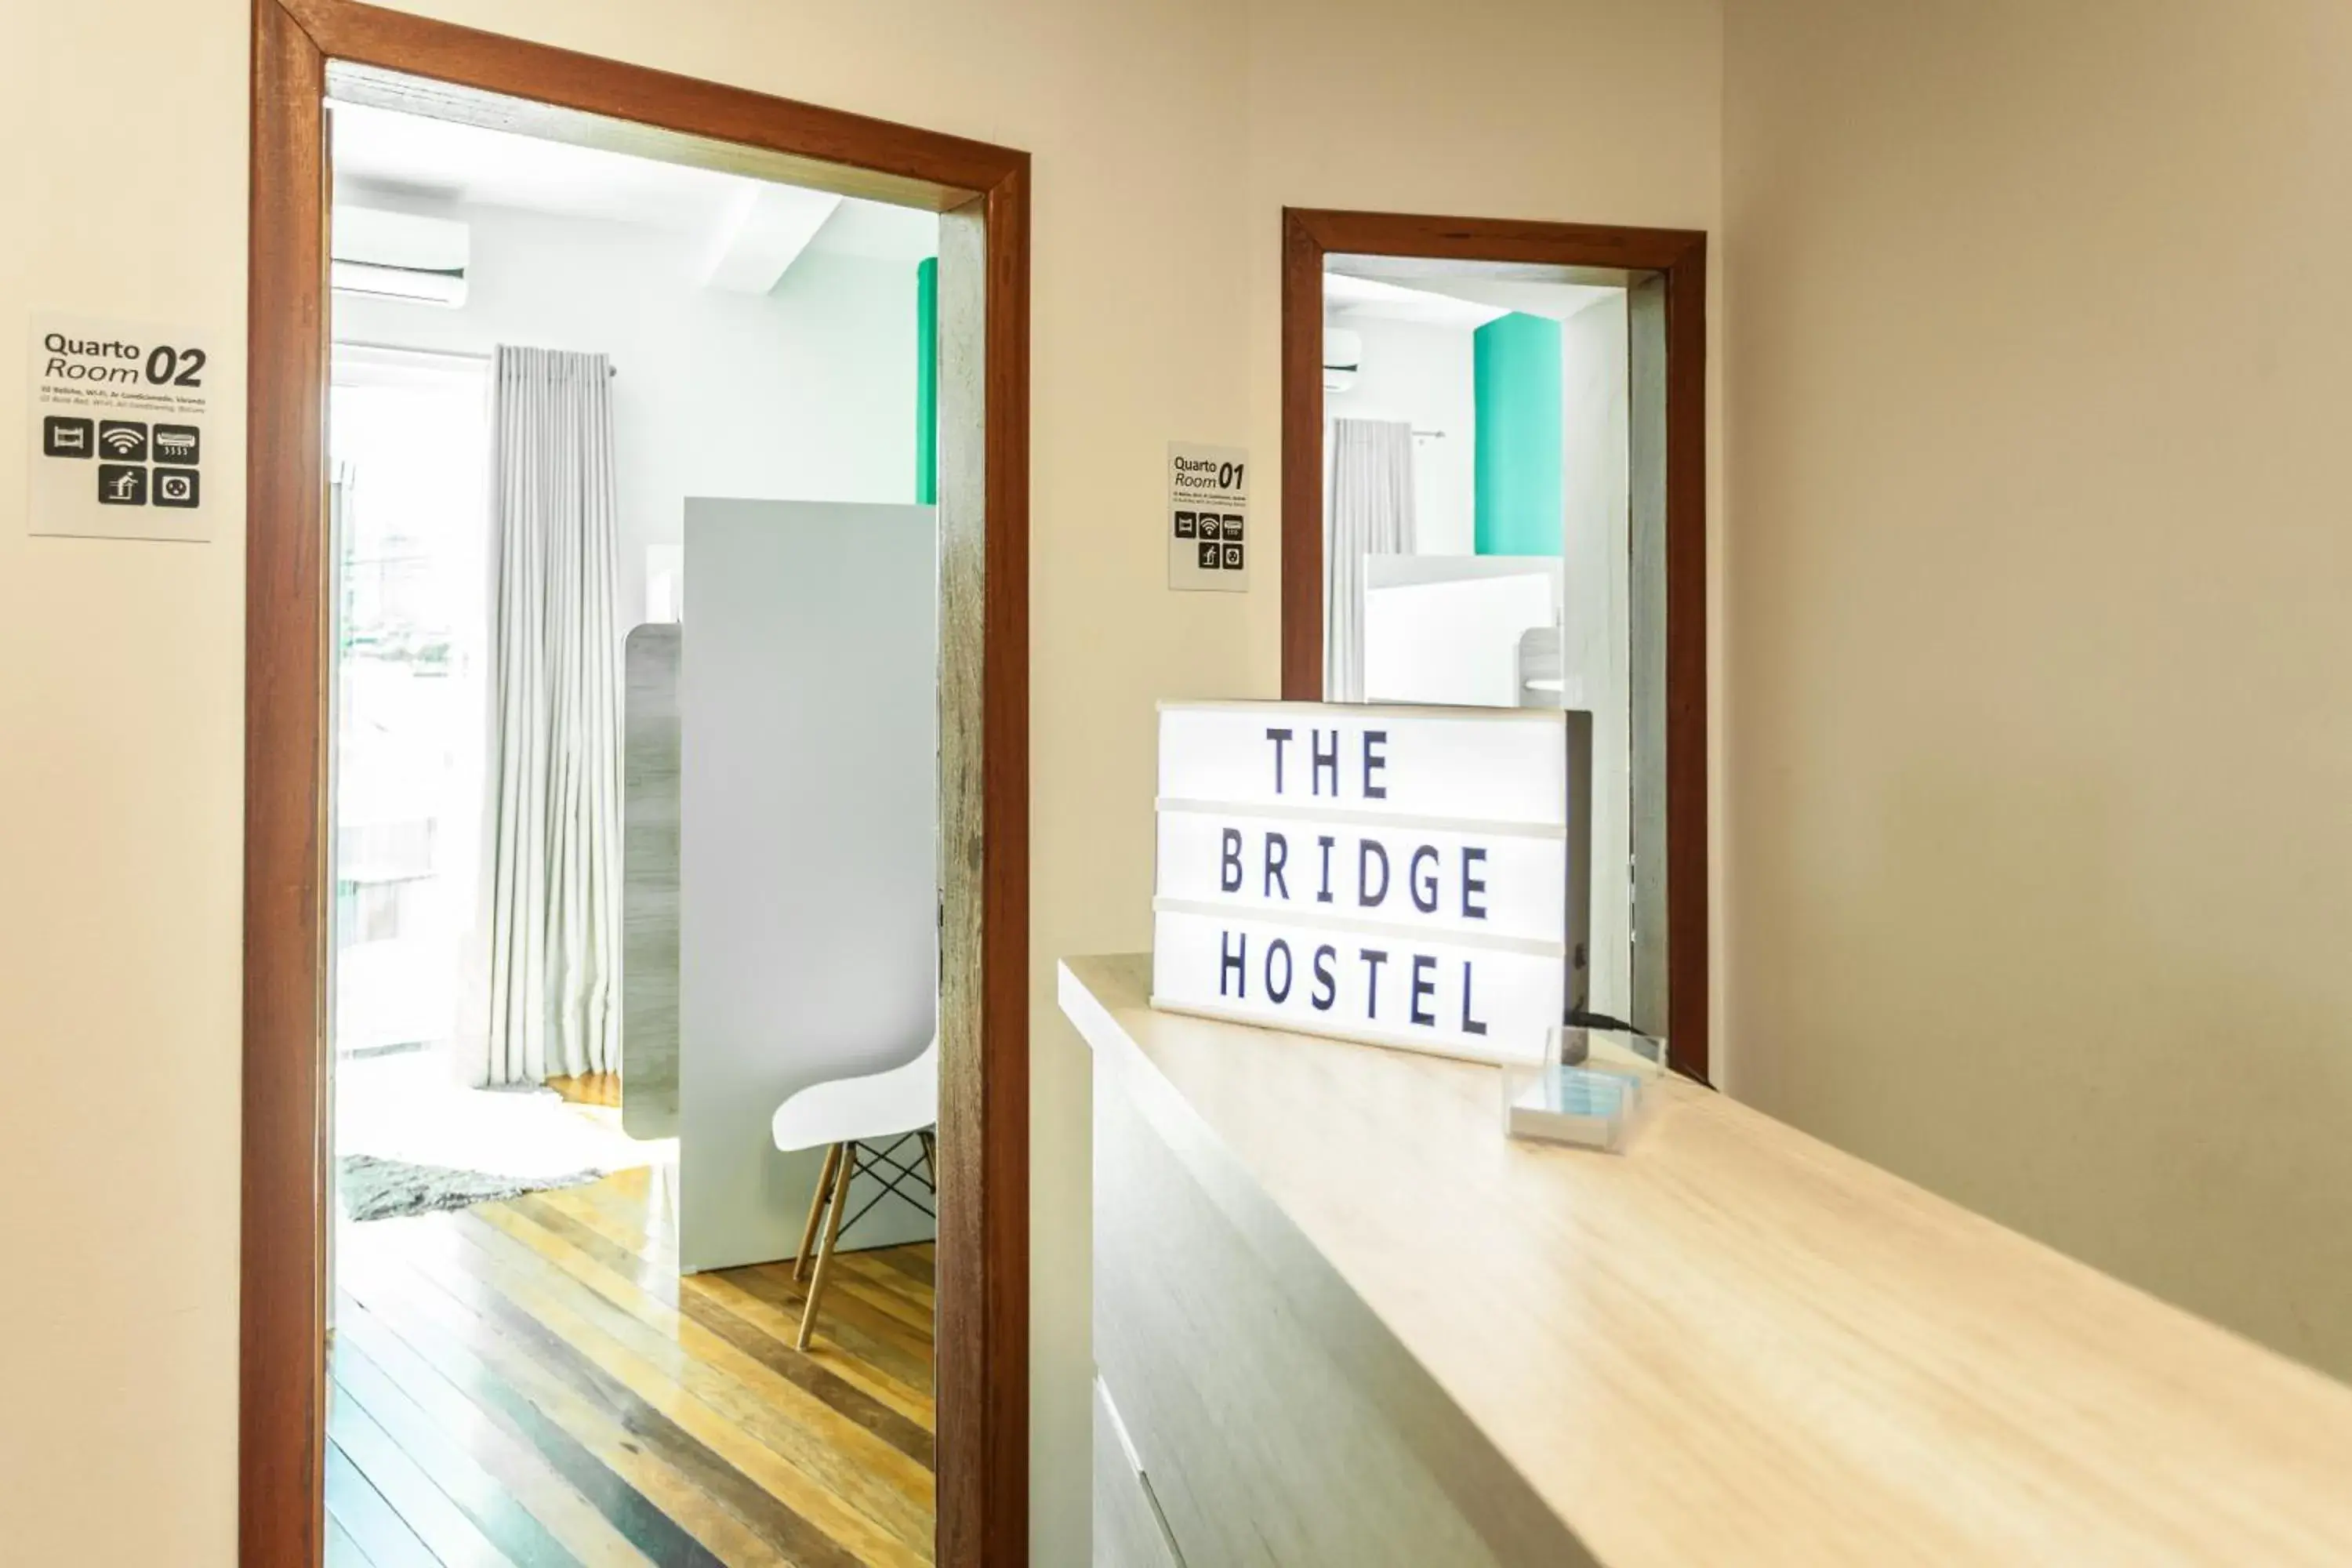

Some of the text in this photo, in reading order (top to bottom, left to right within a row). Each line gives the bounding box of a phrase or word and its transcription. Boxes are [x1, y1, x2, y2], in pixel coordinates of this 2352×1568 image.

[44, 333, 140, 360] Quarto
[45, 358, 139, 384] Room
[146, 345, 206, 387] 02
[1174, 456, 1217, 472] Quarto
[1218, 462, 1244, 490] 01
[1175, 473, 1217, 488] Room
[1266, 728, 1387, 799] THE
[1221, 827, 1487, 920] BRIDGE
[1220, 931, 1487, 1036] HOSTEL
